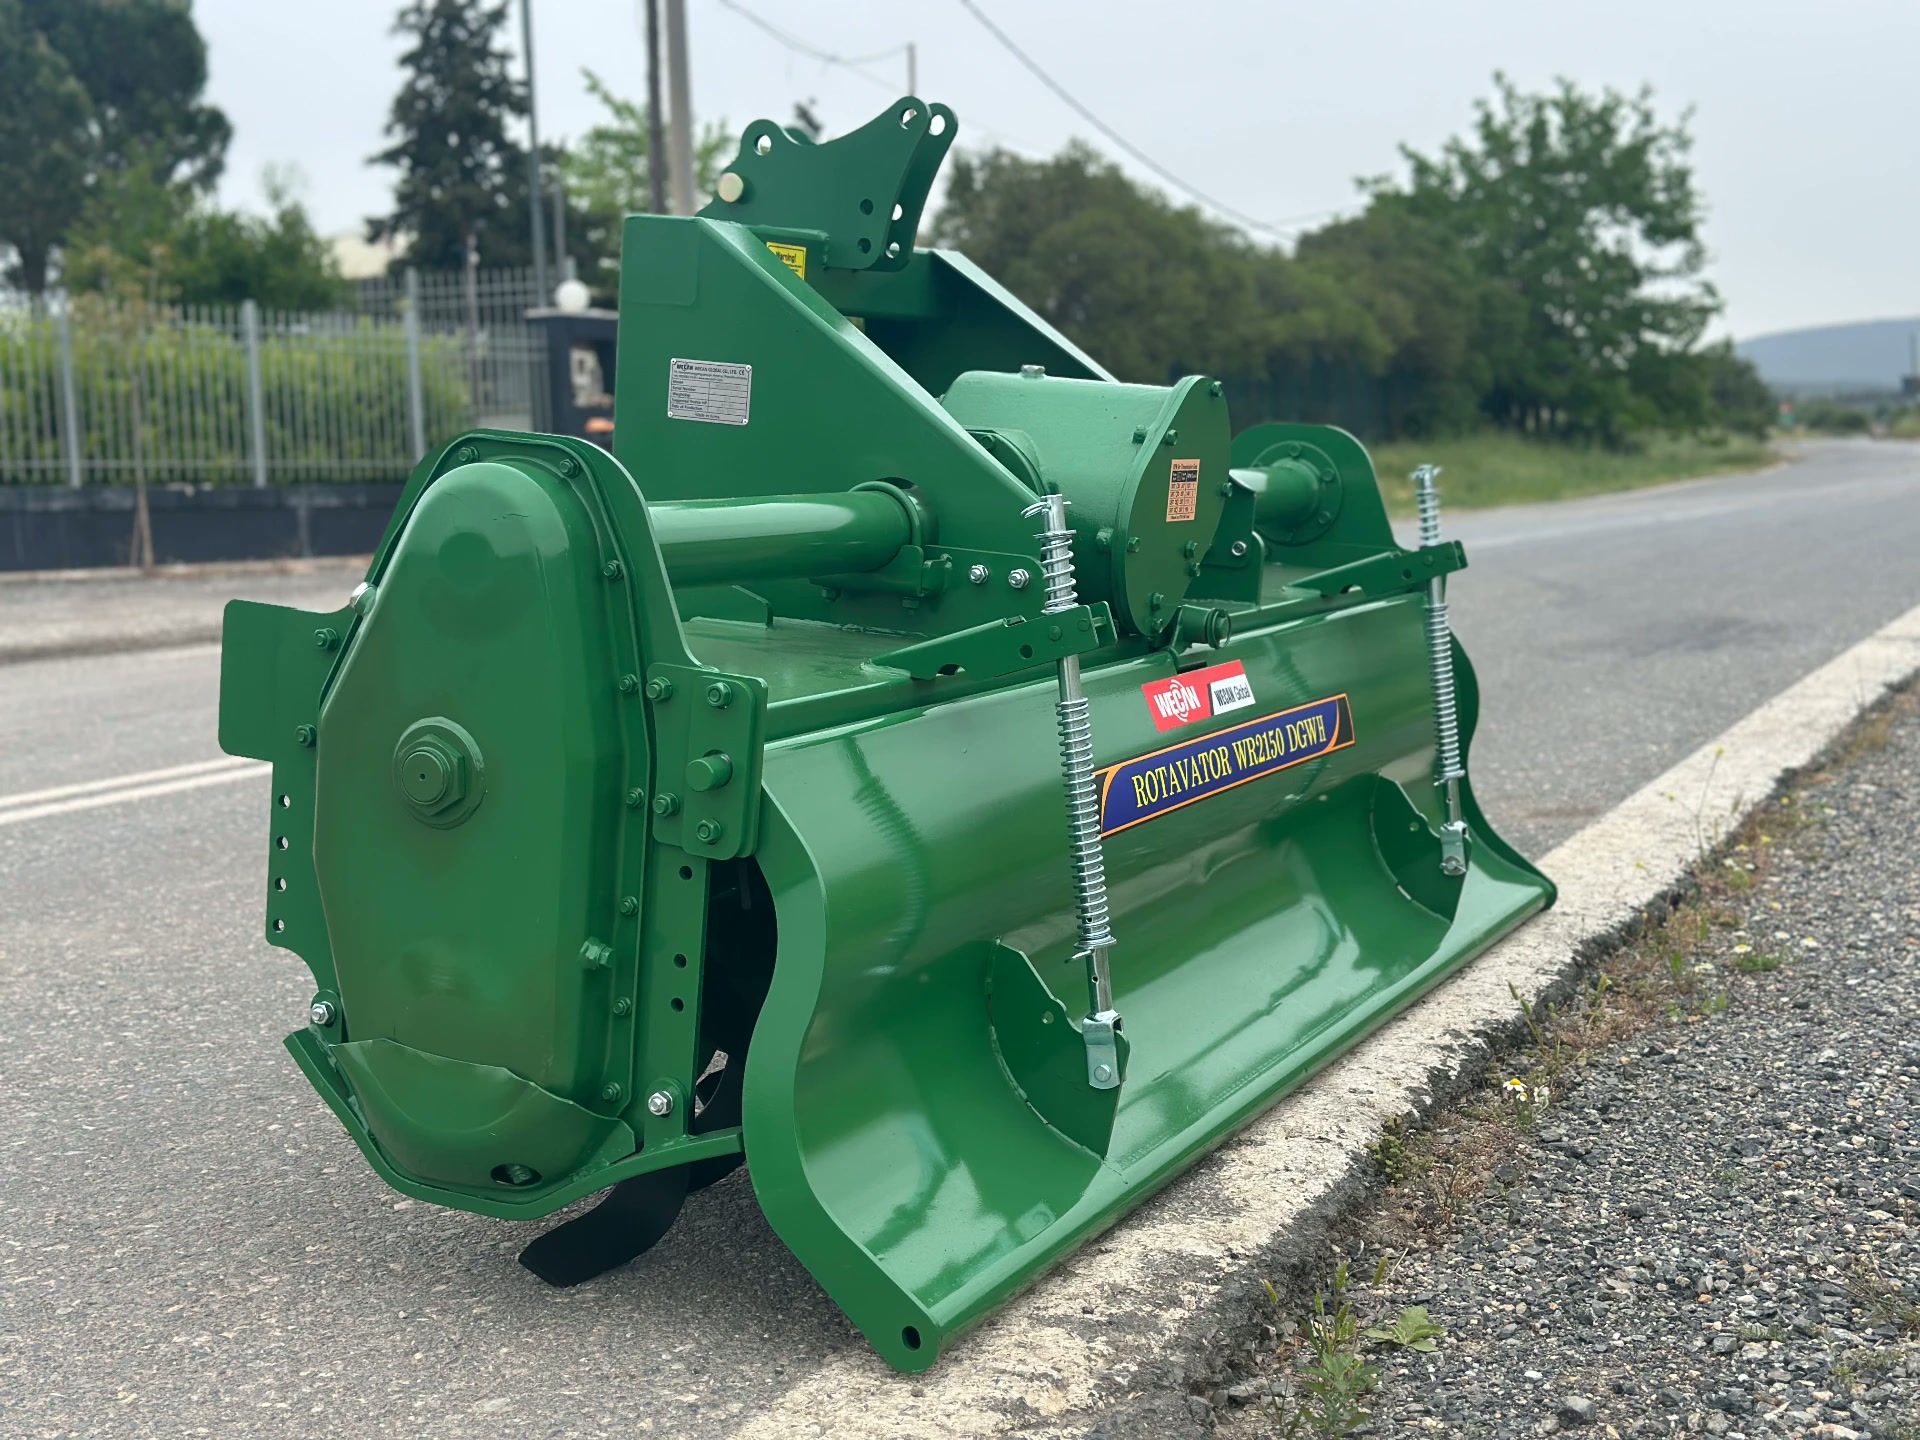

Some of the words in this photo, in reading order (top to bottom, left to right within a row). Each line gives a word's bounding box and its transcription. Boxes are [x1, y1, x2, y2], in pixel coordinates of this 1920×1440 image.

[1153, 683, 1201, 719] WECAN
[1234, 682, 1251, 702] Global
[1132, 746, 1232, 808] ROTAVATOR
[1232, 727, 1285, 771] WR2150
[1286, 715, 1327, 752] DGWH
